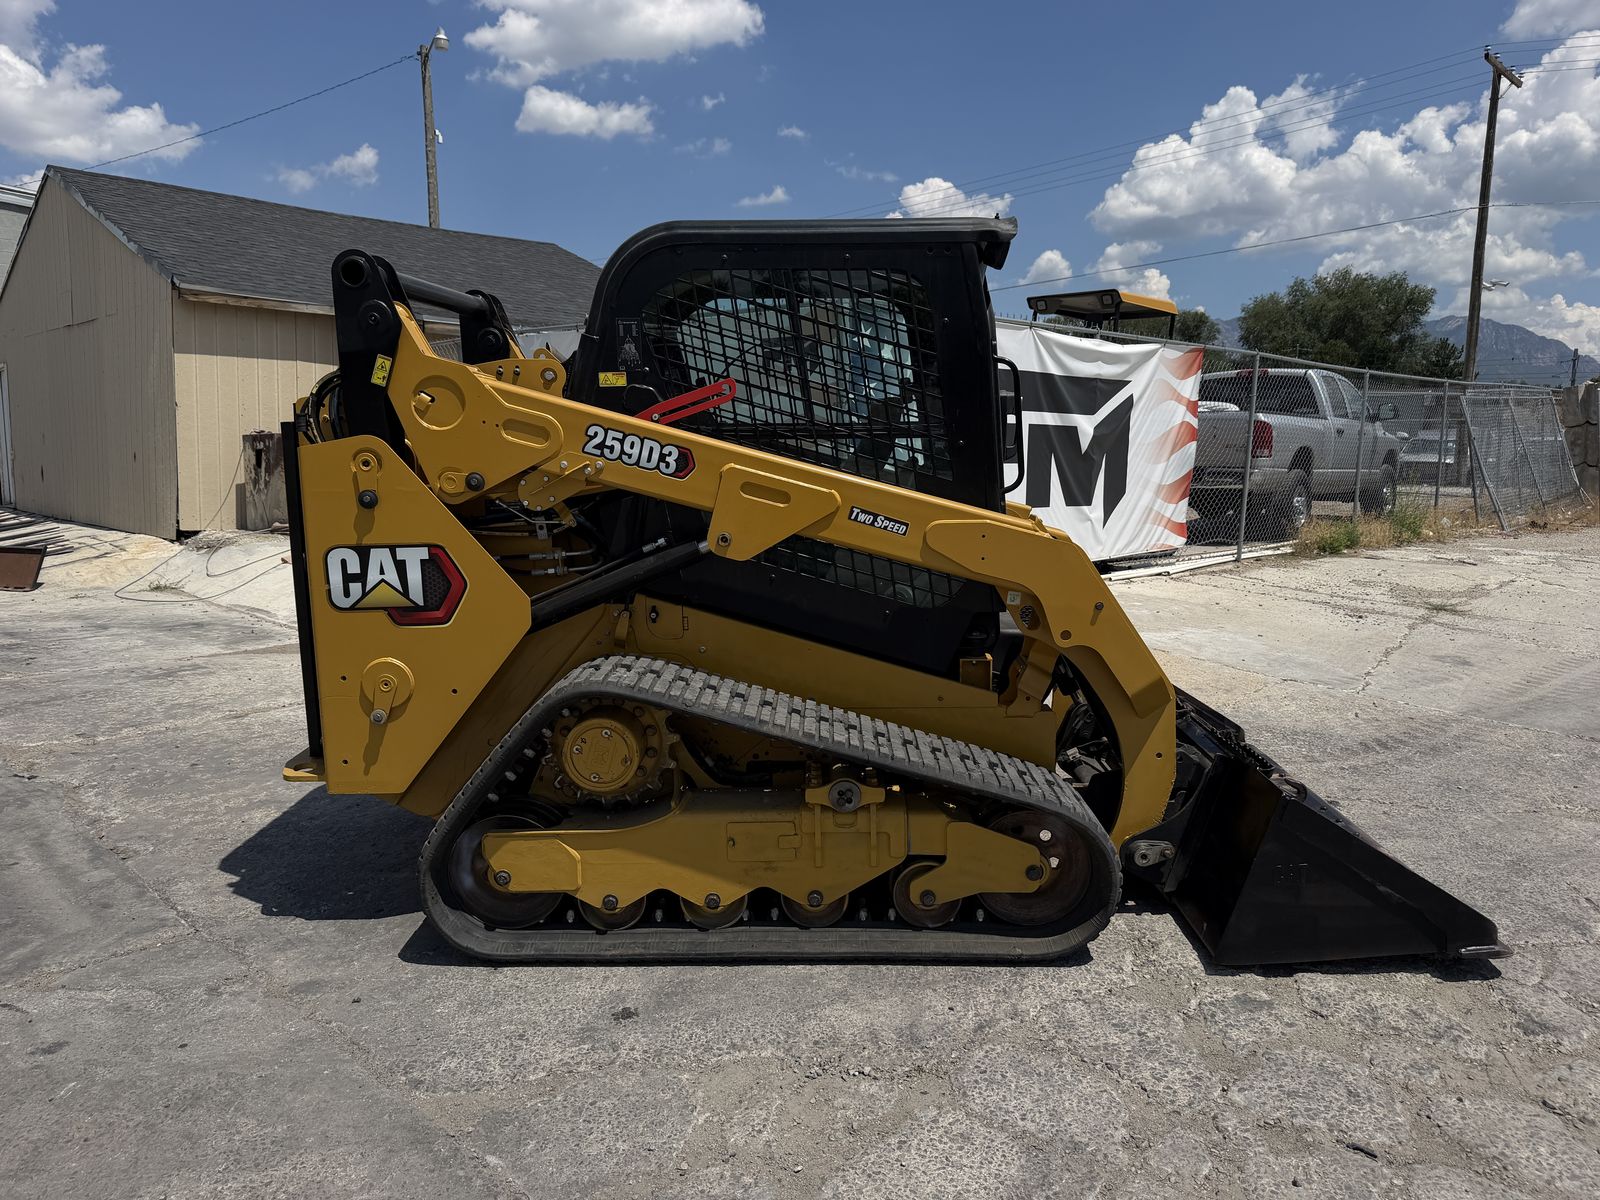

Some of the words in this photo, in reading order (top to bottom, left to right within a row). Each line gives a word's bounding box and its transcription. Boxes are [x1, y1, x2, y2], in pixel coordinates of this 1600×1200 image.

[583, 425, 679, 474] 259D3
[850, 507, 874, 525] TWO
[874, 515, 907, 535] SPEED
[326, 546, 429, 608] CAT
